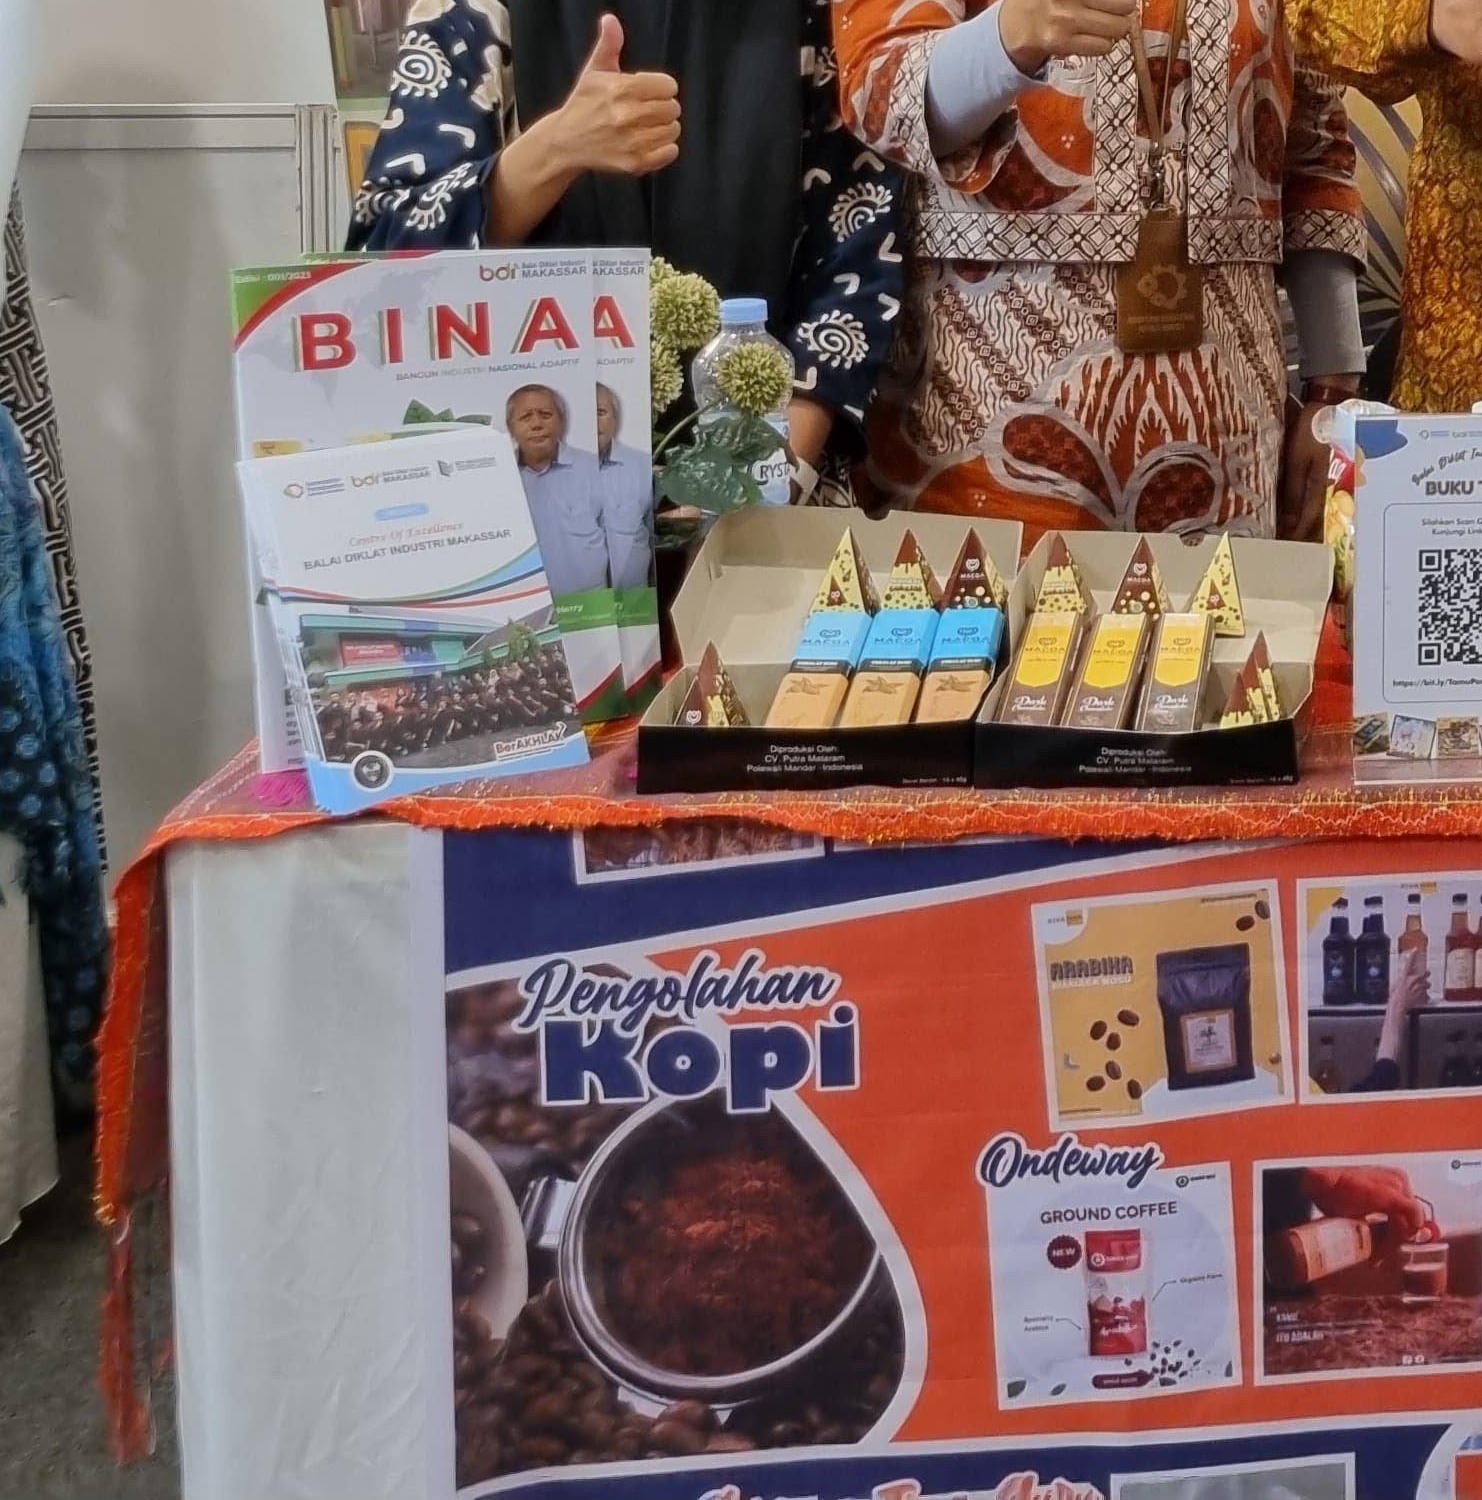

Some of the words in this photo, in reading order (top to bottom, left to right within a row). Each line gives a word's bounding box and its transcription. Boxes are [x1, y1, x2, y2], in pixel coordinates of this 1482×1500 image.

[522, 267, 587, 278] MAKASSAR
[296, 296, 580, 372] BINA
[488, 362, 537, 373] NASIONAL
[540, 357, 580, 368] ADAPTIF
[1425, 480, 1474, 496] BUKU
[1456, 517, 1475, 526] Scan
[1467, 527, 1482, 536] Link
[304, 556, 341, 570] BALAI
[345, 548, 387, 563] DIKLAT
[390, 538, 446, 556] INDUSTRI
[447, 529, 512, 547] MAKASSAR
[1050, 955, 1134, 982] ARABIKA
[517, 954, 836, 1029] Pengolahan
[543, 1006, 855, 1111] Kopi
[980, 1135, 1160, 1189] Ondeway
[1040, 1207, 1112, 1225] GROUND
[1115, 1200, 1178, 1220] COFFEE
[1051, 1247, 1076, 1258] NEW
